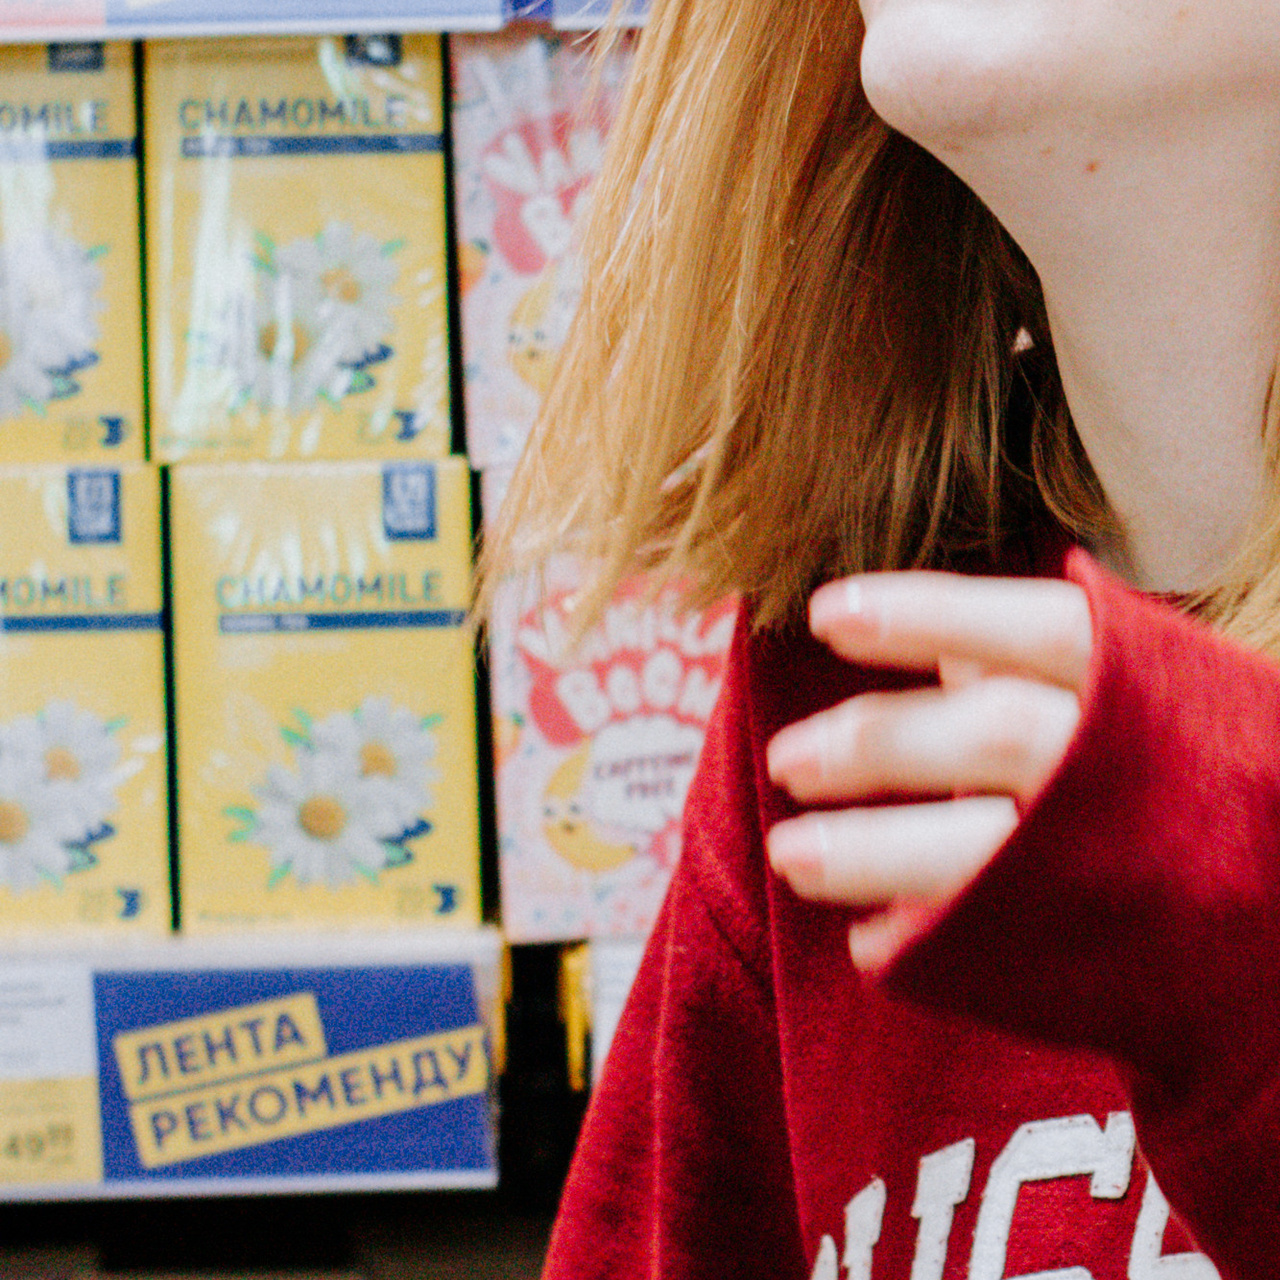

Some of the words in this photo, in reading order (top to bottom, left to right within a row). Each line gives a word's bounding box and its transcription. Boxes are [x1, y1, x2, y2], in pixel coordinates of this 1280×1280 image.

[178, 96, 406, 130] CHAMOMILE
[216, 570, 443, 608] CHAMOMILE
[137, 1011, 306, 1085] ЛЕНТА
